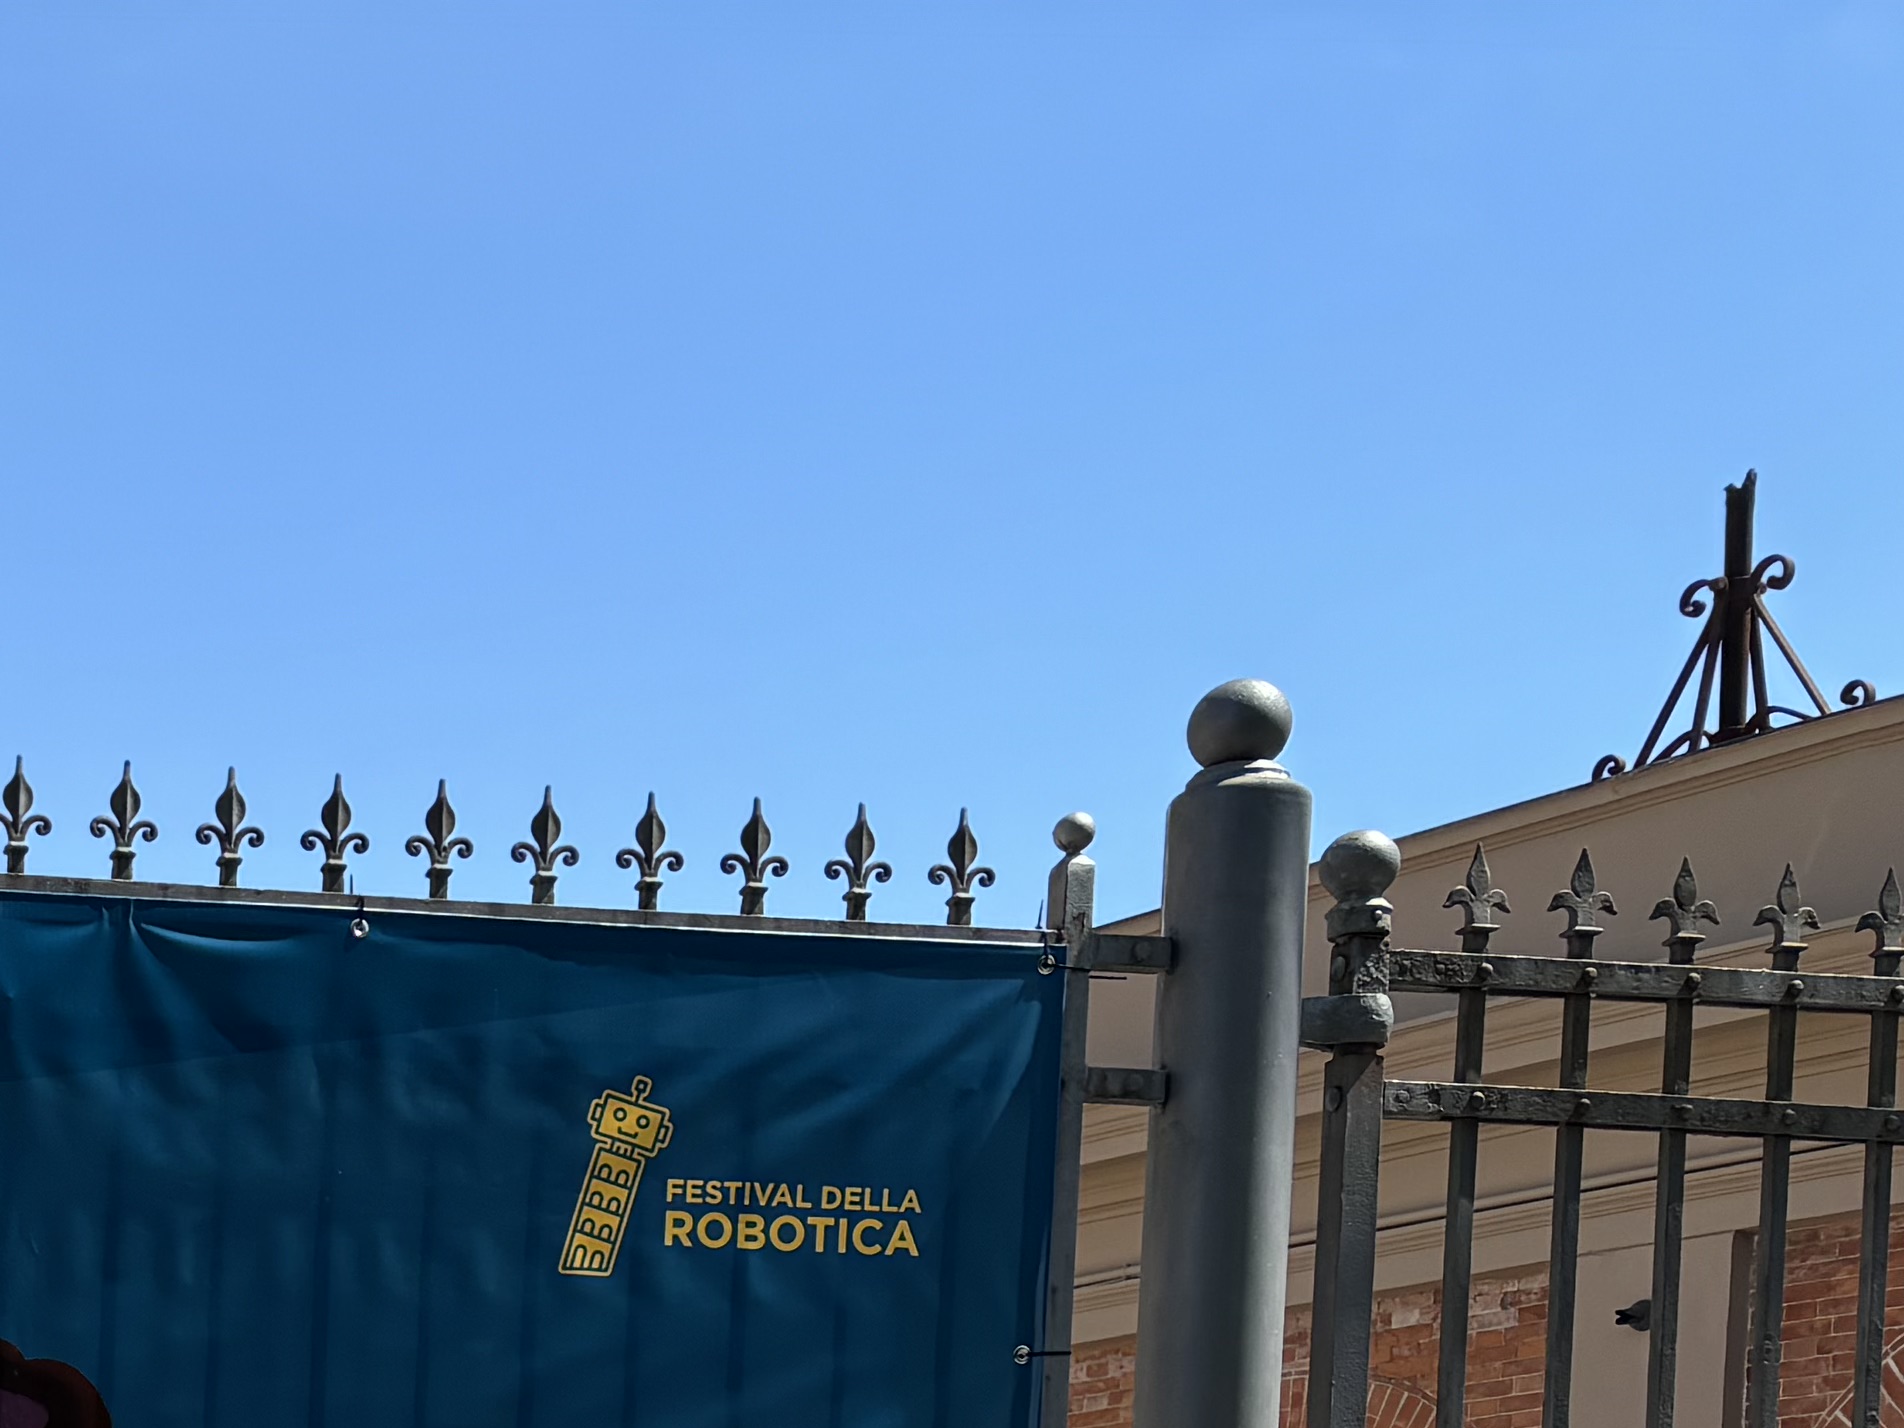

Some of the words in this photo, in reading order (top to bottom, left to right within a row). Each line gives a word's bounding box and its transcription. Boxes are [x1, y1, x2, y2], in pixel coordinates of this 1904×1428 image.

[666, 1179, 812, 1209] FESTIVAL
[821, 1186, 922, 1214] DELLA
[664, 1210, 920, 1257] ROBOTICA
